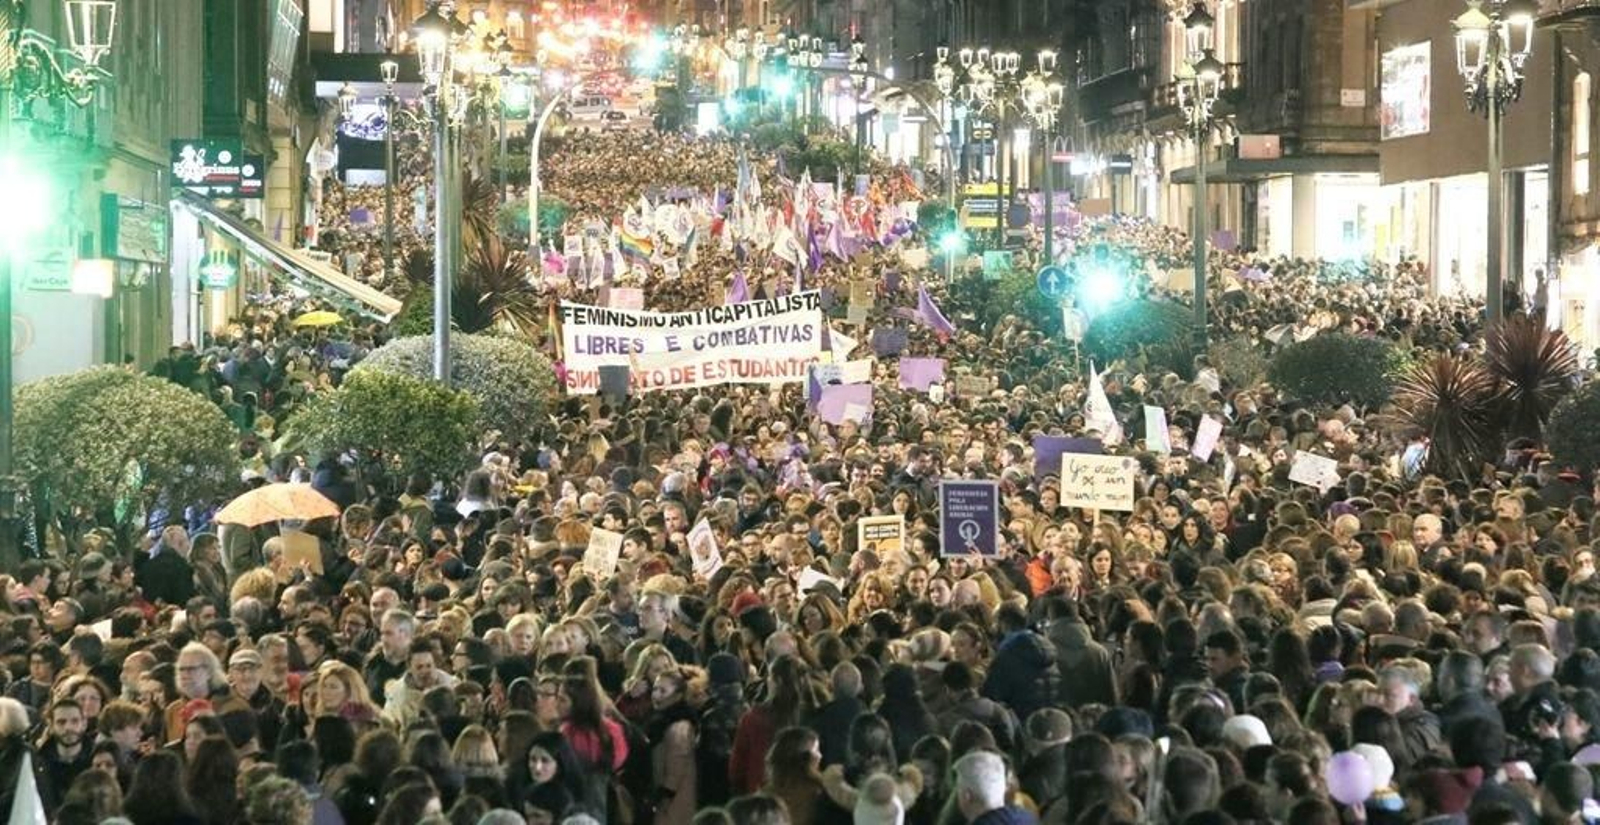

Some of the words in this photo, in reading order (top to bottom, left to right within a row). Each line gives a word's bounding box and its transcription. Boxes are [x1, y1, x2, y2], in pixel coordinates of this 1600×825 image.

[561, 307, 666, 328] FEMINISMO
[669, 292, 821, 327] ANTICAPITALISTA
[575, 335, 644, 356] LIBRES
[665, 334, 682, 353] E
[693, 324, 813, 352] COMBATIVAS
[670, 366, 696, 385] DE
